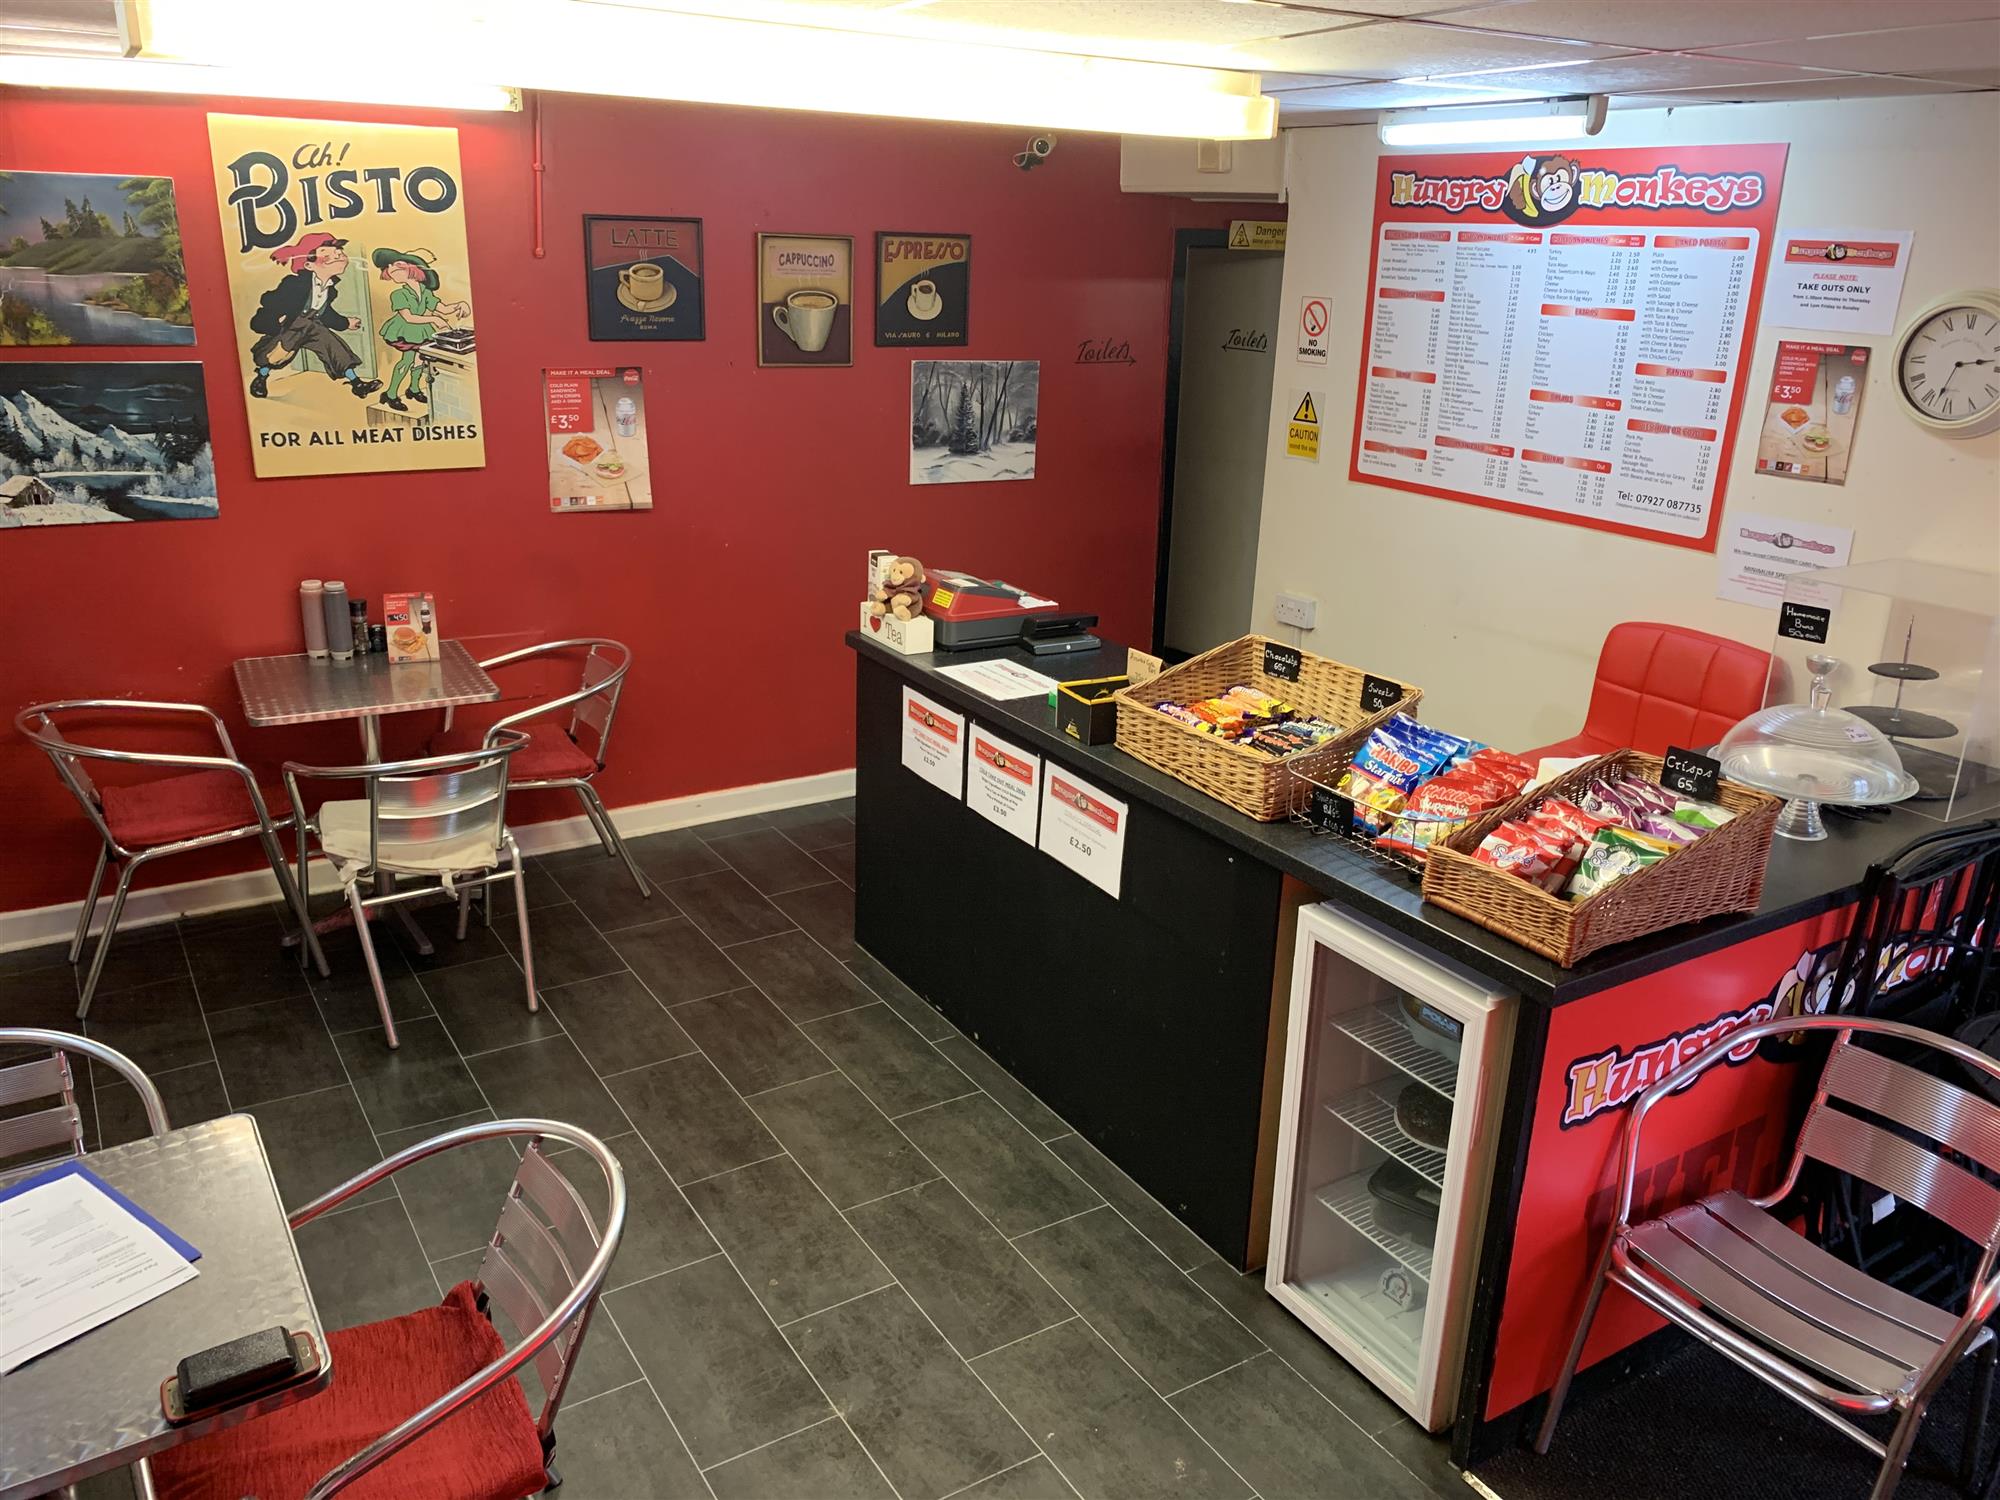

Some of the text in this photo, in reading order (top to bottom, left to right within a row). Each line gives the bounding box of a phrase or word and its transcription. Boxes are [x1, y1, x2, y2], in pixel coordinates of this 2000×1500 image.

[227, 151, 458, 253] BISTO
[1391, 171, 1508, 212] Hungry
[611, 227, 680, 247] LATTE
[1256, 225, 1286, 238] Danger
[778, 252, 835, 268] CAPPUCCINO
[883, 239, 965, 263] ESPRESSO
[1797, 282, 1871, 294] TAKE OUTS ONLY
[1078, 337, 1130, 362] Toilets
[1226, 329, 1268, 350] Toilets
[1299, 347, 1326, 357] SMOKING
[260, 424, 478, 448] FOR ALL MEAT DISHES
[1290, 428, 1318, 441] CAUTION
[1616, 490, 1633, 501] Tel:
[1635, 494, 1664, 506] 07927
[1666, 499, 1702, 513] 087735
[1744, 565, 1774, 577] MINIMUM
[1786, 606, 1825, 622] Homemade
[1794, 618, 1814, 630] Buns
[864, 612, 902, 646] I Tea
[1369, 682, 1394, 697] Sweets
[1370, 743, 1420, 775] HARIBO
[1666, 756, 1712, 780] Crisps
[1364, 760, 1406, 786] Starmix
[1421, 784, 1482, 805] HARIBO
[1069, 836, 1092, 856] £2.50
